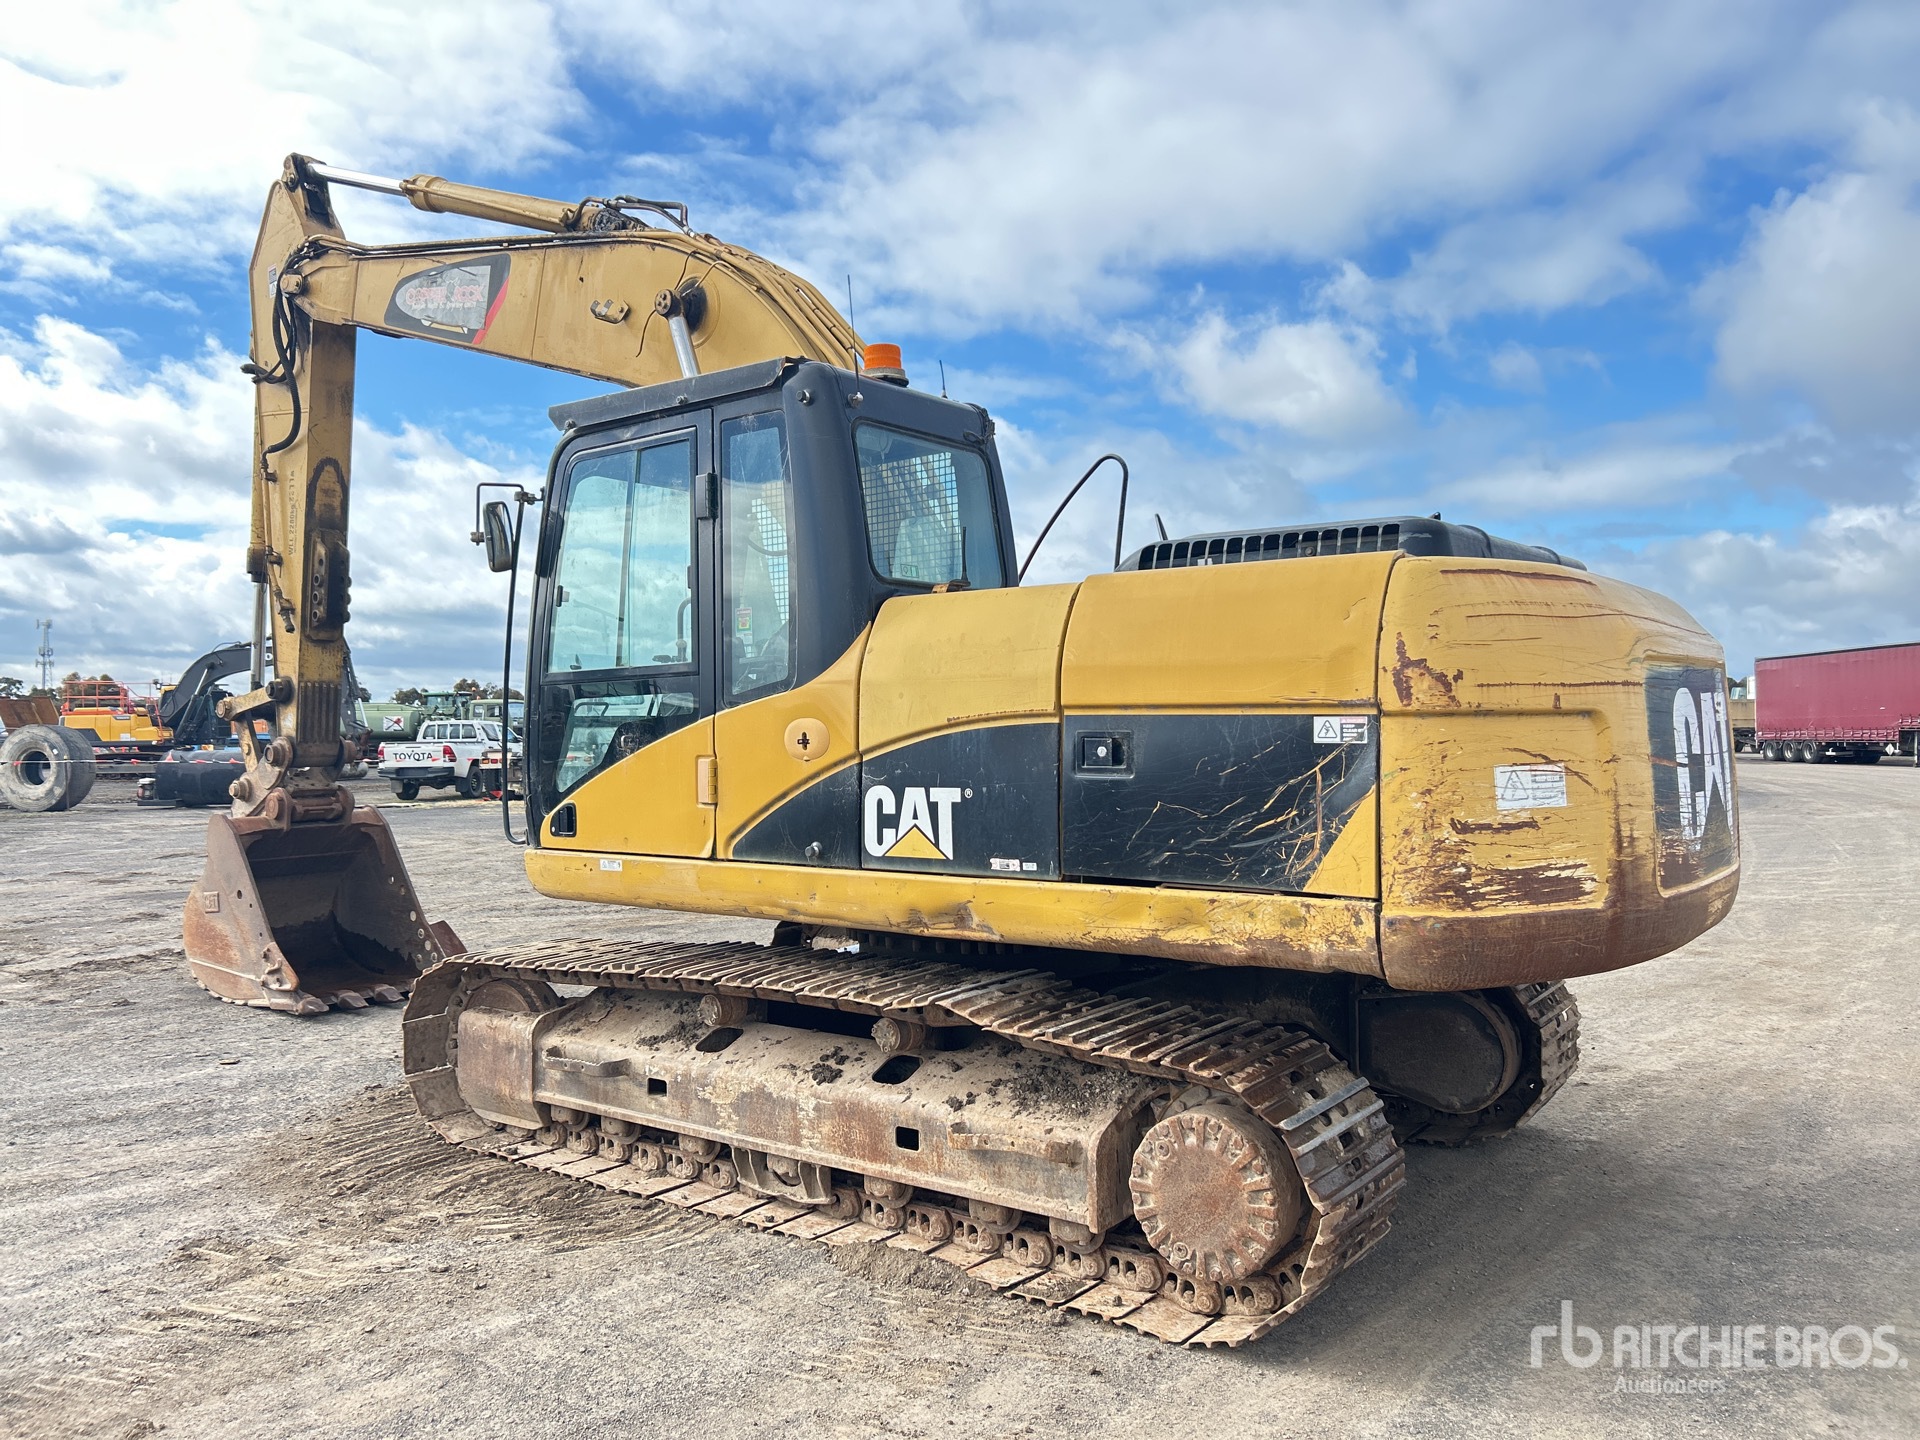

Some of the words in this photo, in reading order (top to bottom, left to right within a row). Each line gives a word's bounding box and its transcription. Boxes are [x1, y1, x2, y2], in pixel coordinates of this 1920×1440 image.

[393, 752, 433, 761] TOYOTA
[1673, 687, 1734, 846] CAT
[864, 784, 962, 861] CAT
